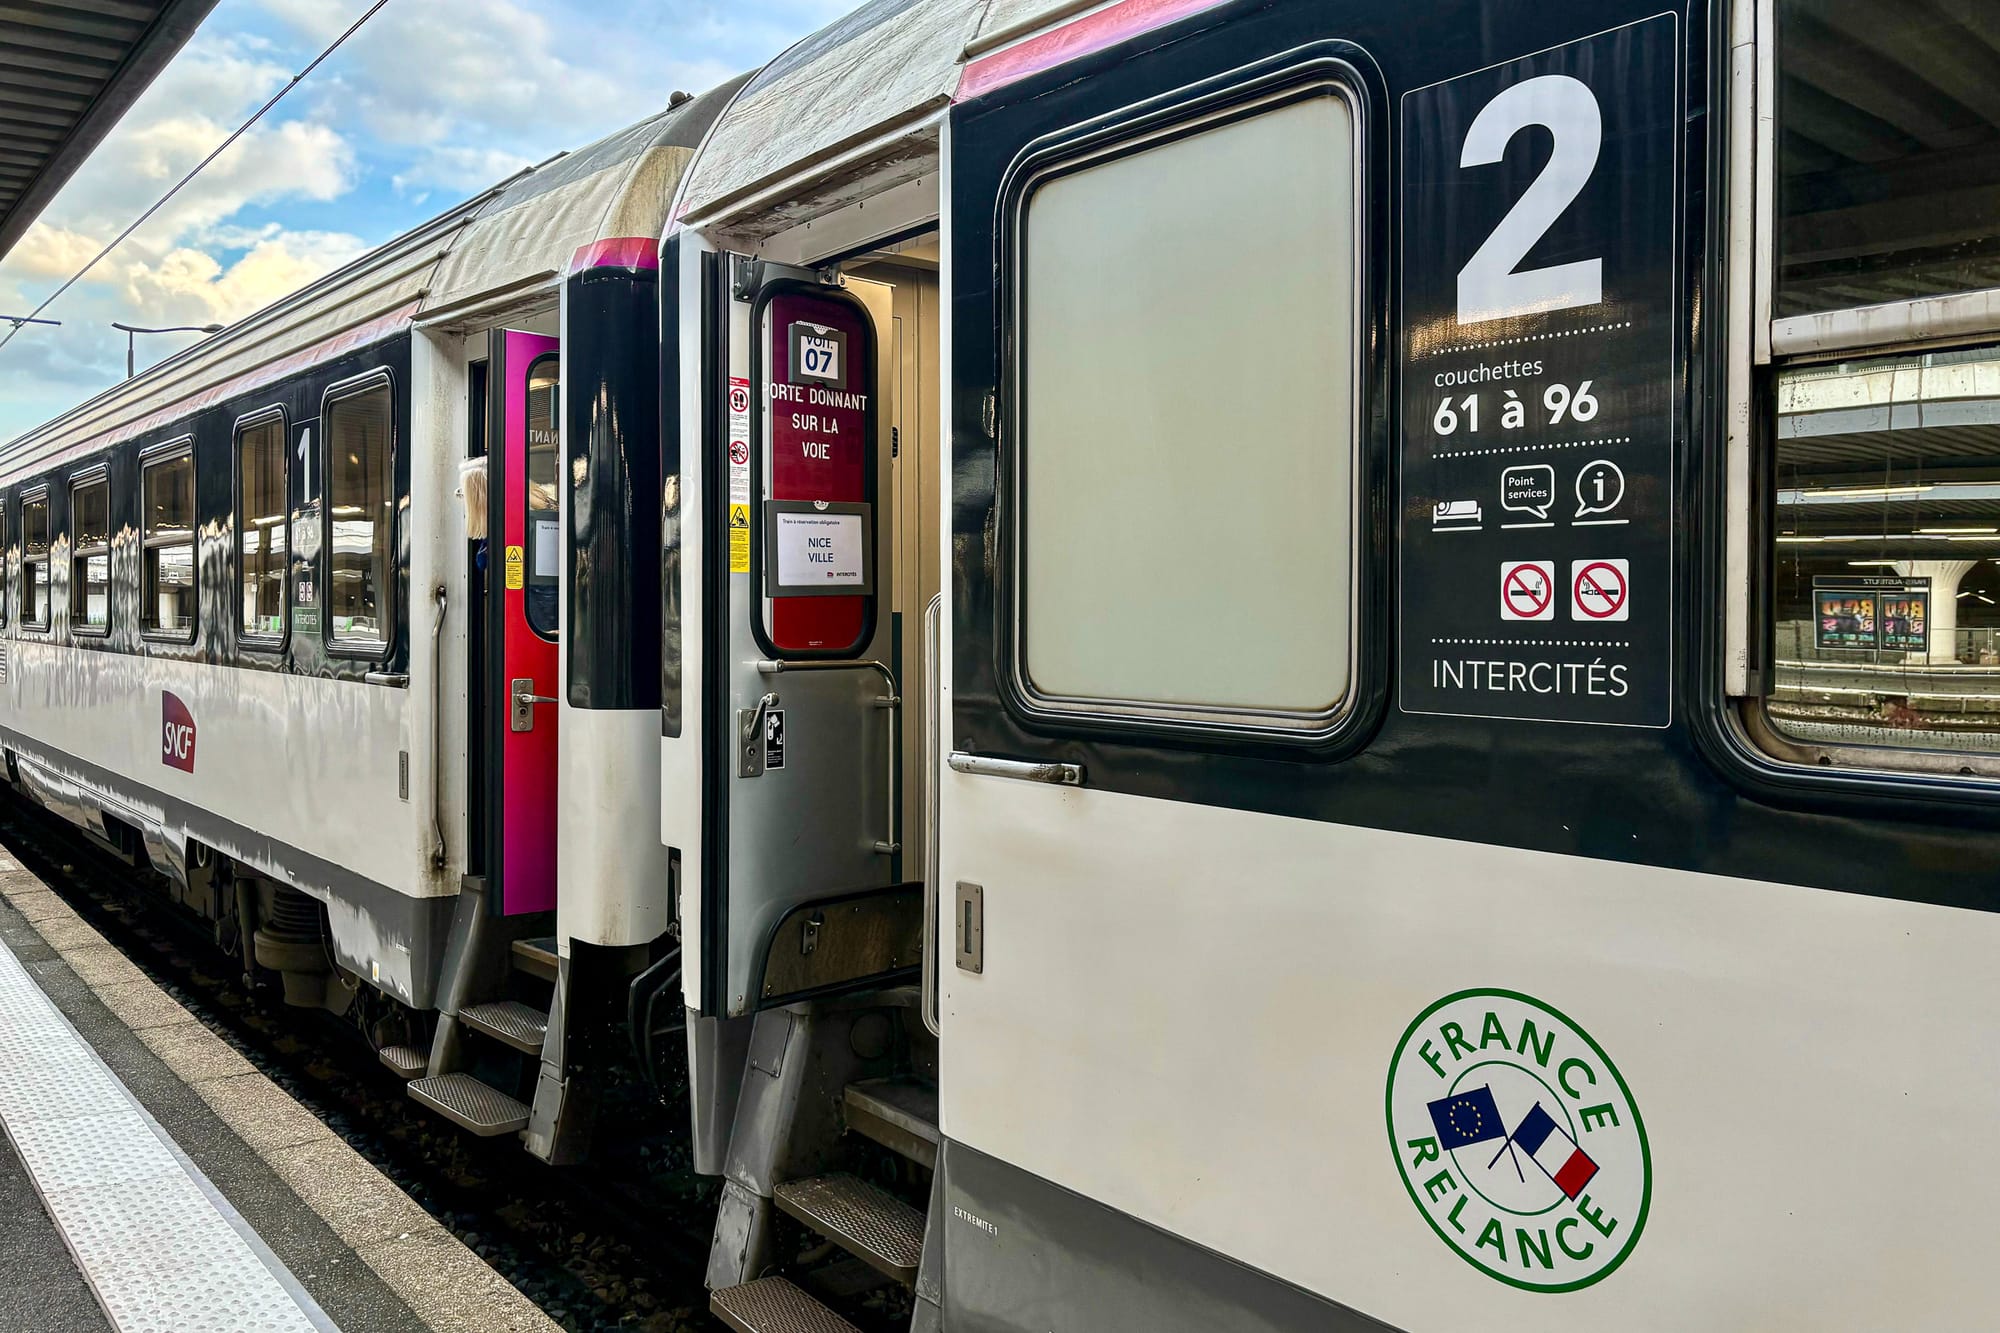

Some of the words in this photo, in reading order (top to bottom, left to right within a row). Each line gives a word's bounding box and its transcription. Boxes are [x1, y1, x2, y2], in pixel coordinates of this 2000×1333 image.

[1456, 74, 1603, 325] 2
[805, 348, 833, 373] 07
[1434, 359, 1544, 388] couchettes
[809, 388, 868, 411] DONNANT
[1433, 393, 1479, 436] 61
[1501, 390, 1525, 430] à
[1543, 380, 1599, 425] 96
[792, 412, 818, 432] SUR
[822, 417, 839, 434] LA
[801, 441, 831, 460] VOIE
[297, 427, 310, 503] 1
[1507, 487, 1548, 500] services
[1508, 475, 1535, 487] Point
[808, 537, 832, 548] NICE
[808, 552, 834, 563] VILLE
[1433, 657, 1629, 697] INTERCITÉS
[164, 721, 193, 760] SNCF
[1418, 1011, 1620, 1133] FRANCE
[1407, 1136, 1618, 1269] RELANCE
[954, 1206, 993, 1234] EXTREMITE
